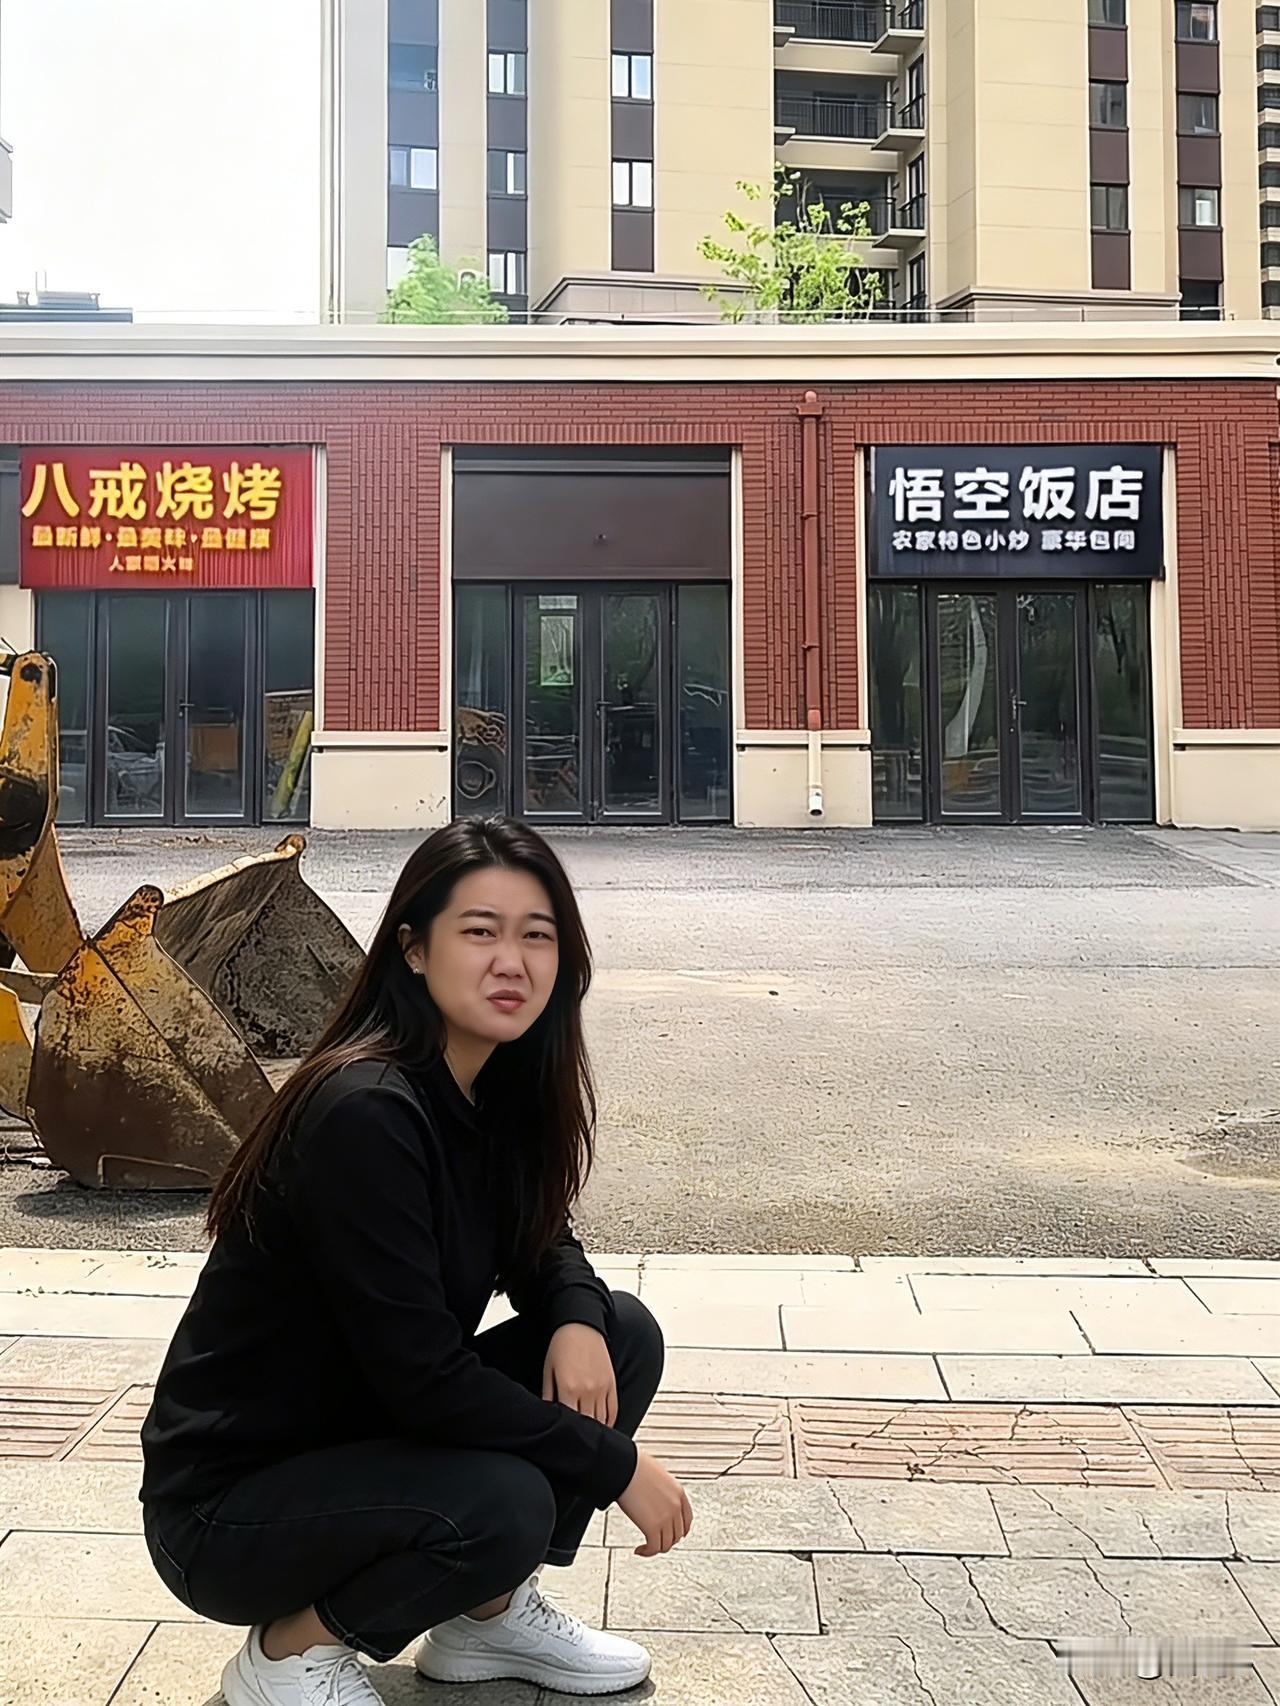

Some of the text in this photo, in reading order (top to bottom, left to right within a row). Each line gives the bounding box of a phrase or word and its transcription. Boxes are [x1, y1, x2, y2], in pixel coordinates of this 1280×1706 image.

[21, 462, 282, 520] 八戒烧烤
[888, 465, 1143, 522] 悟空饭店
[892, 529, 1136, 551] 农家特色小炒 豪华包间
